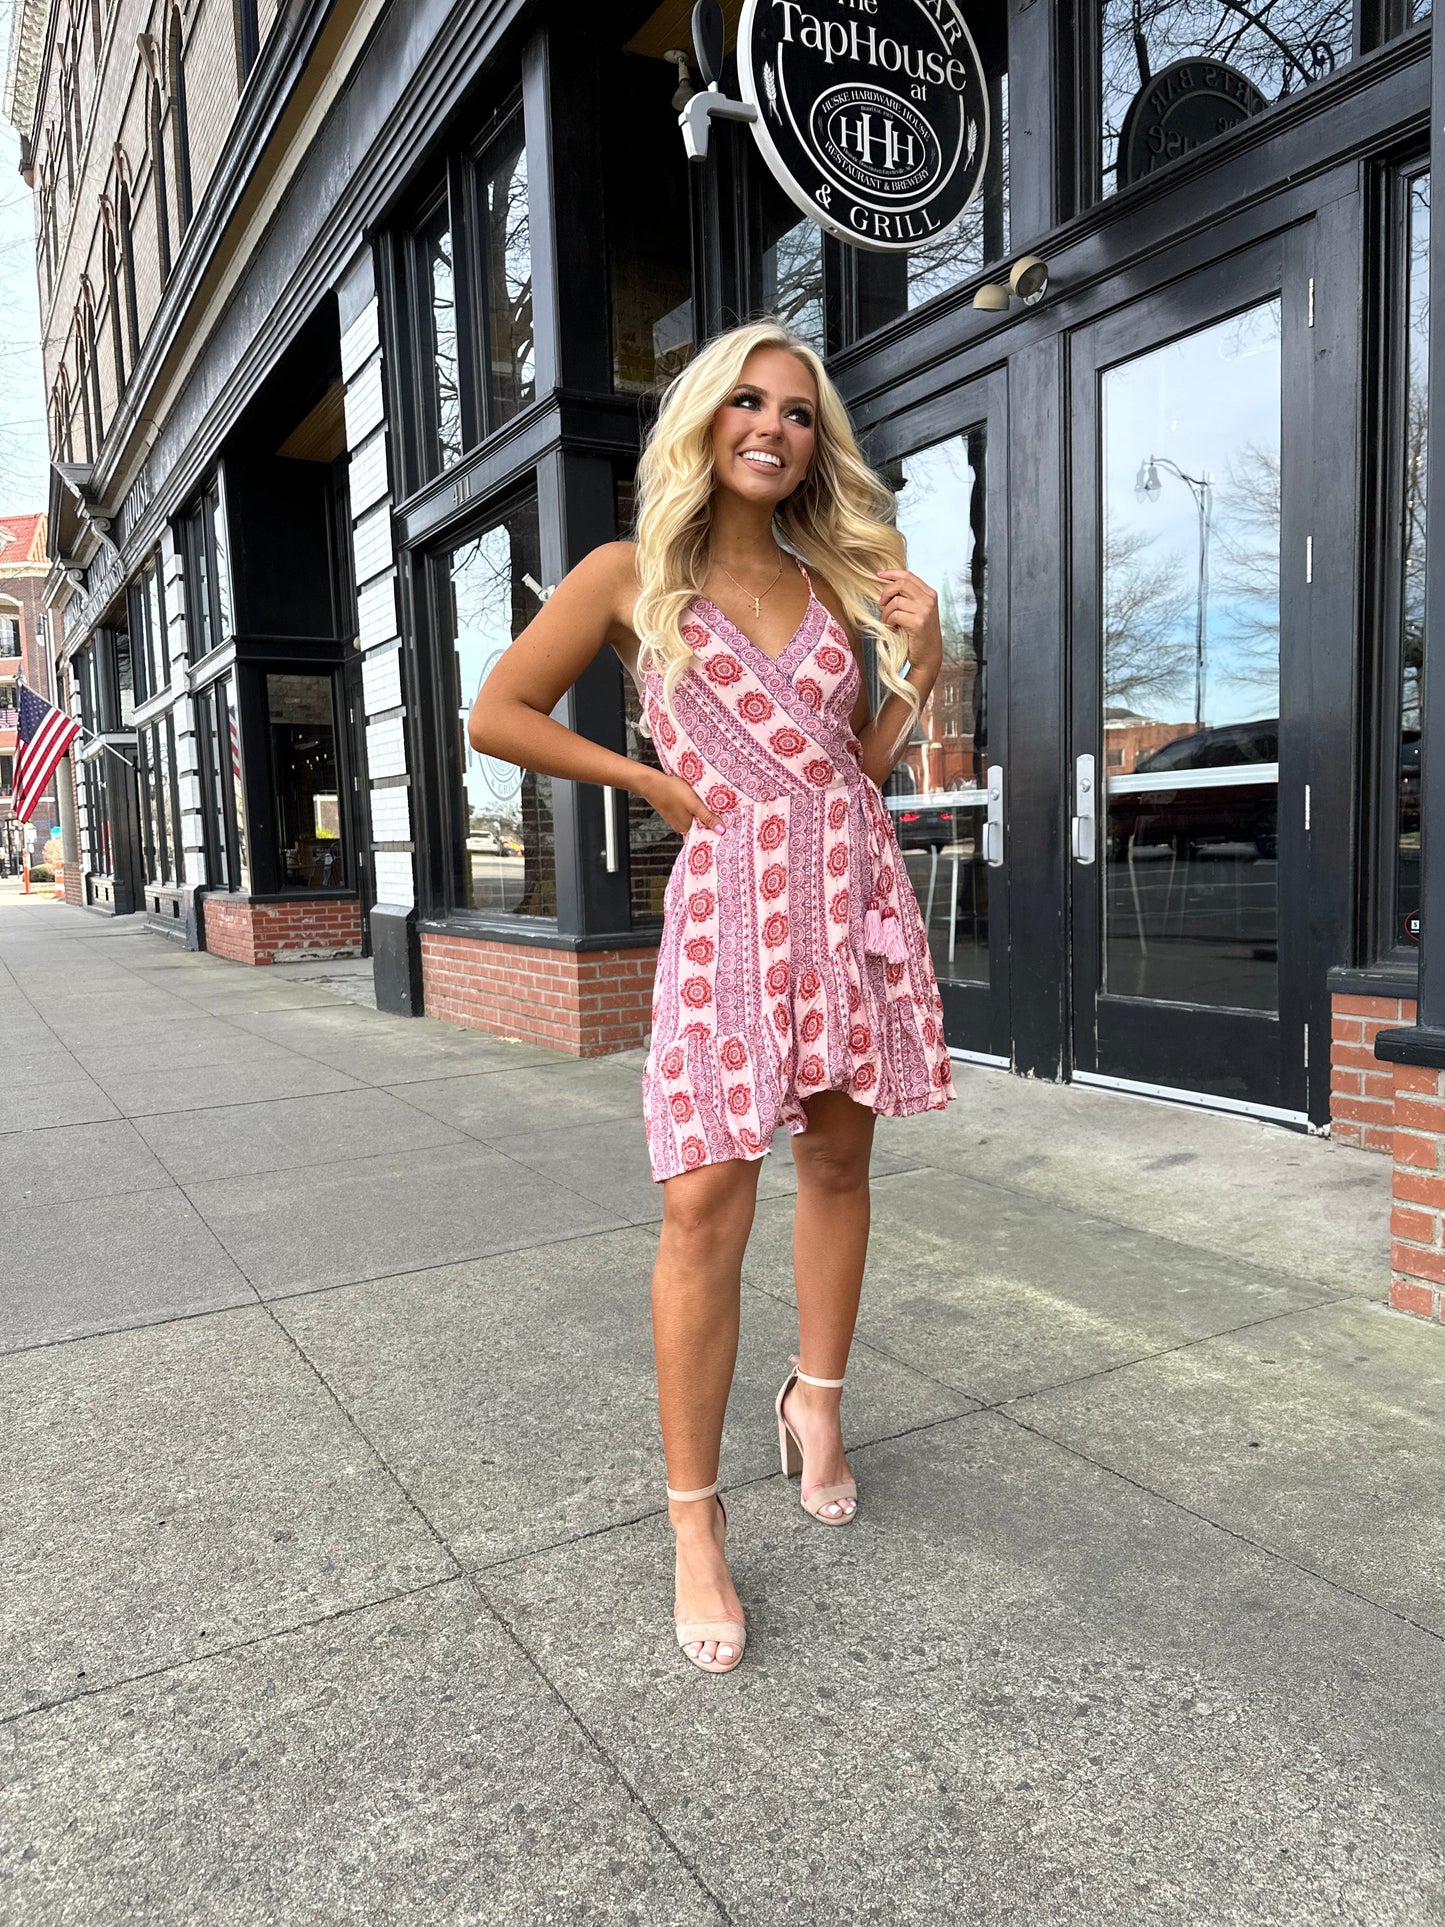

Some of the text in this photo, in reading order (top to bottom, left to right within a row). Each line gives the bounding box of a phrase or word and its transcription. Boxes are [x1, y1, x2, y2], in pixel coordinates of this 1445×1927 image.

[772, 0, 967, 91] TapHouse
[926, 0, 962, 46] AR
[821, 90, 931, 142] HUSKE HARDWARE HOUSE
[910, 83, 928, 102] at
[825, 140, 882, 189] RESTAURANT
[883, 181, 891, 191] &
[891, 166, 930, 191] BREWERY
[815, 183, 941, 239] & GRILL
[452, 475, 471, 506] 411
